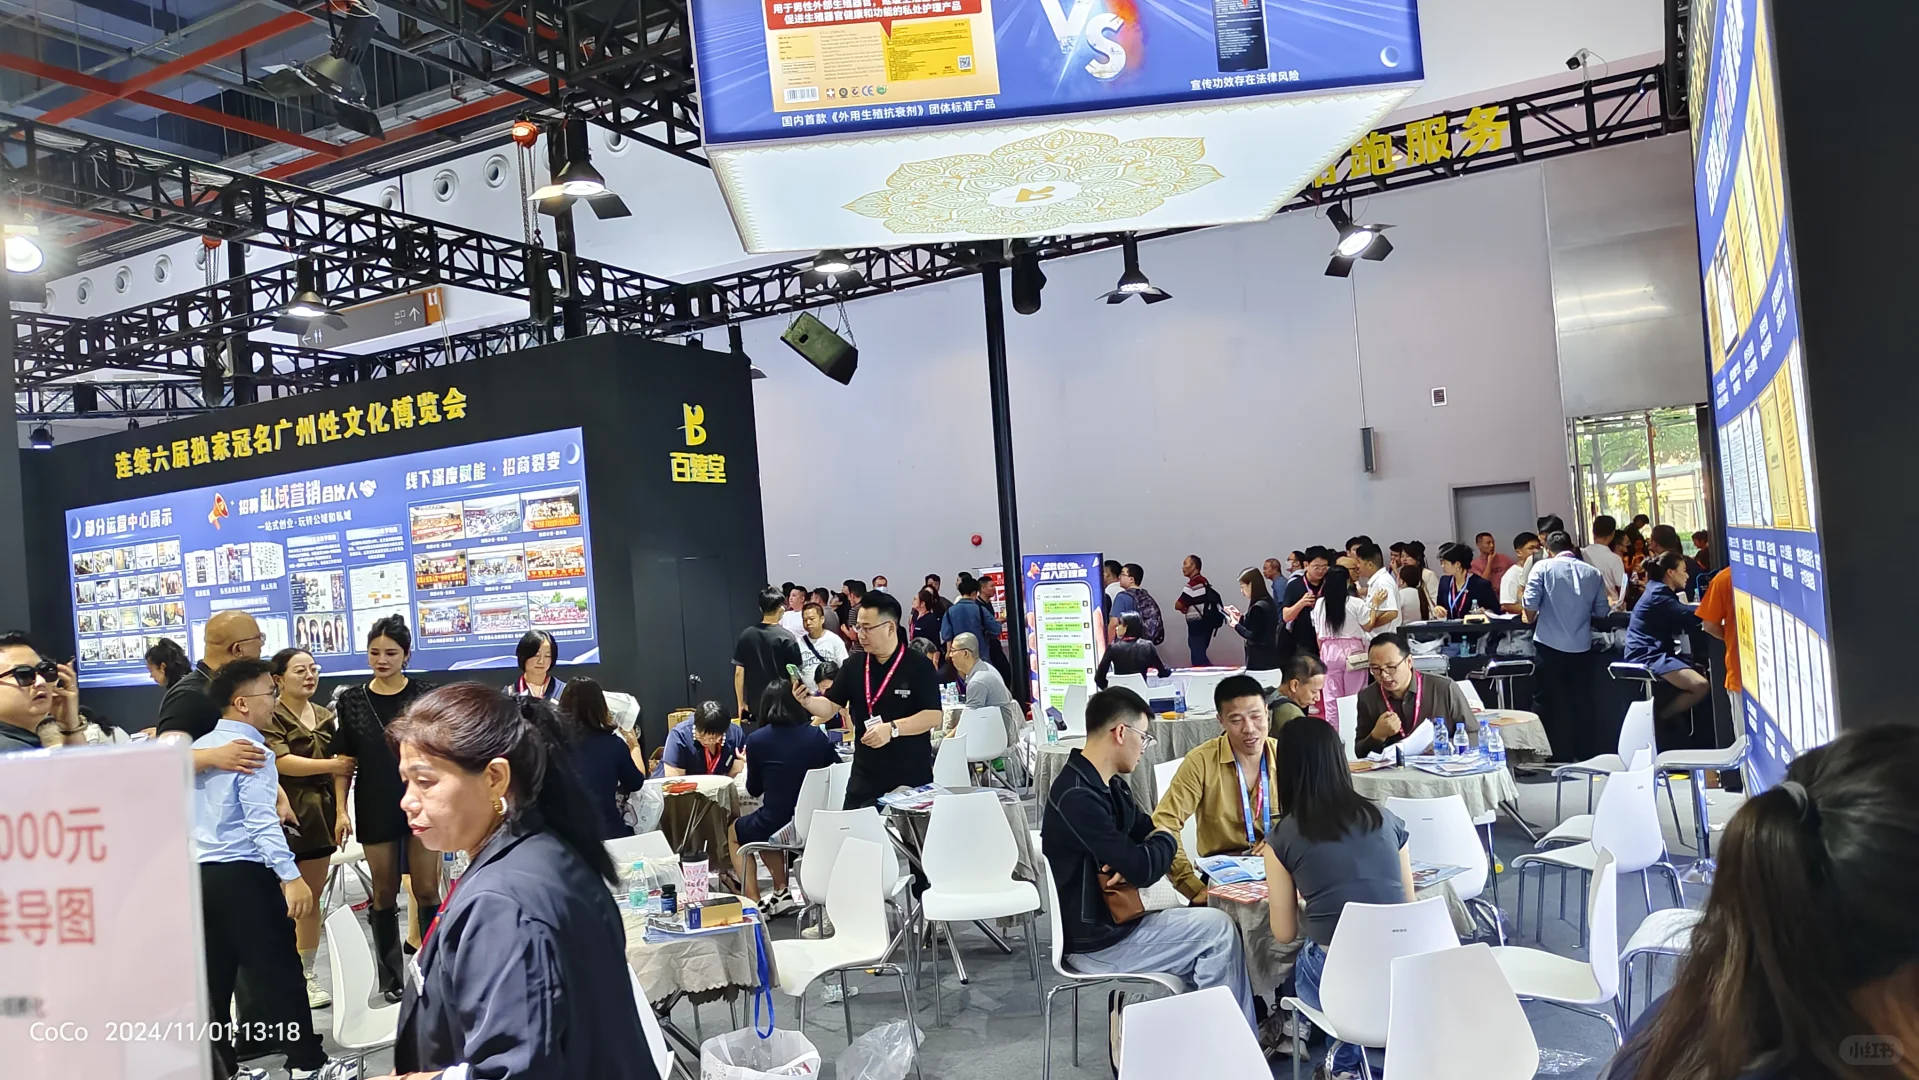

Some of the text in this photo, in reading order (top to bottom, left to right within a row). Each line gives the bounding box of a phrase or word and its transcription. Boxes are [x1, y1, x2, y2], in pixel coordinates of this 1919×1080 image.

[784, 1, 962, 25] 促进生殖器官健康和功能的私处护理产品
[1039, 0, 1127, 81] VS
[1190, 70, 1300, 91] 宣传功效存在法律风险
[114, 387, 468, 479] 连续六届独家冠名广州性文化博览会
[84, 507, 173, 538] 部分运营中心展示
